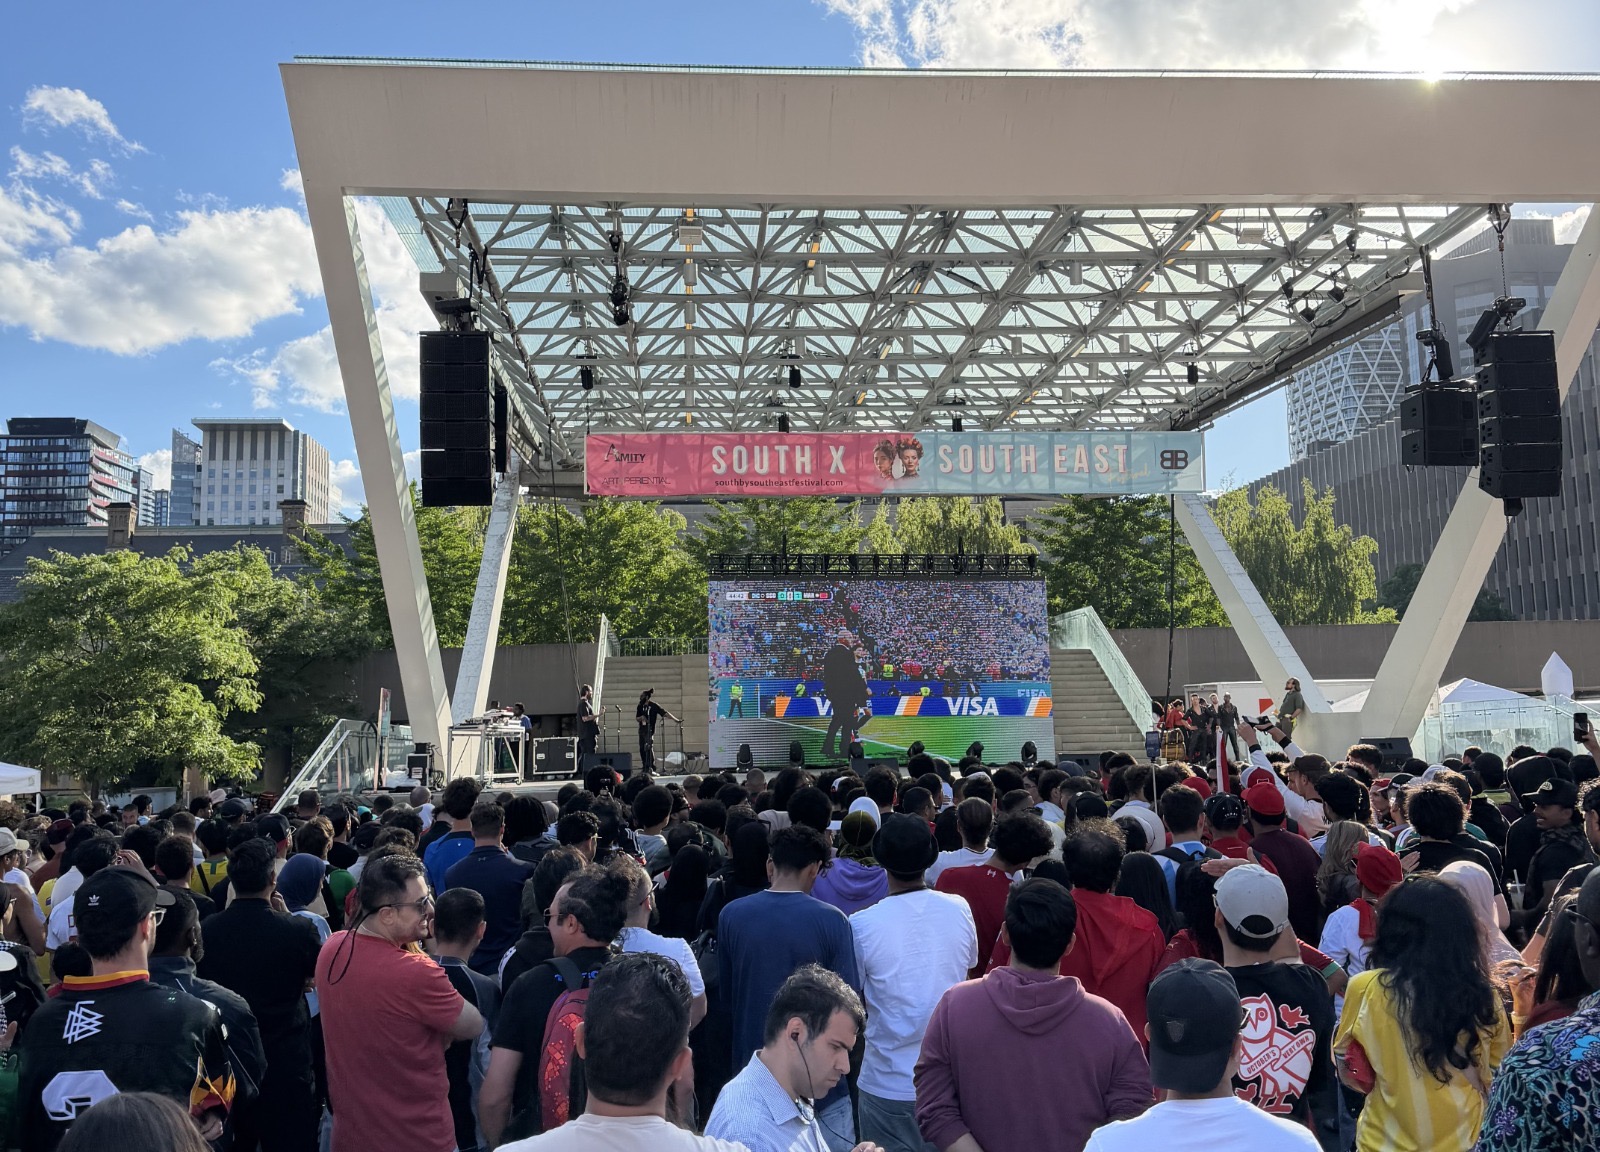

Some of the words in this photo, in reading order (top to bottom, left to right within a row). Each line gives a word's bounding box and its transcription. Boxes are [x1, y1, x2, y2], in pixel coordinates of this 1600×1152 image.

[604, 443, 646, 462] AMITY
[712, 445, 810, 475] SOUTH
[828, 445, 847, 475] X
[938, 444, 1038, 474] SOUTH
[1054, 444, 1129, 474] EAST
[714, 478, 843, 488] southbysoutheastfestival.com
[1017, 688, 1047, 698] FIFA
[944, 696, 998, 715] VISA
[1247, 1050, 1276, 1074] OCTOBER'S
[1282, 1045, 1297, 1058] VERY
[1296, 1035, 1310, 1048] OWN
